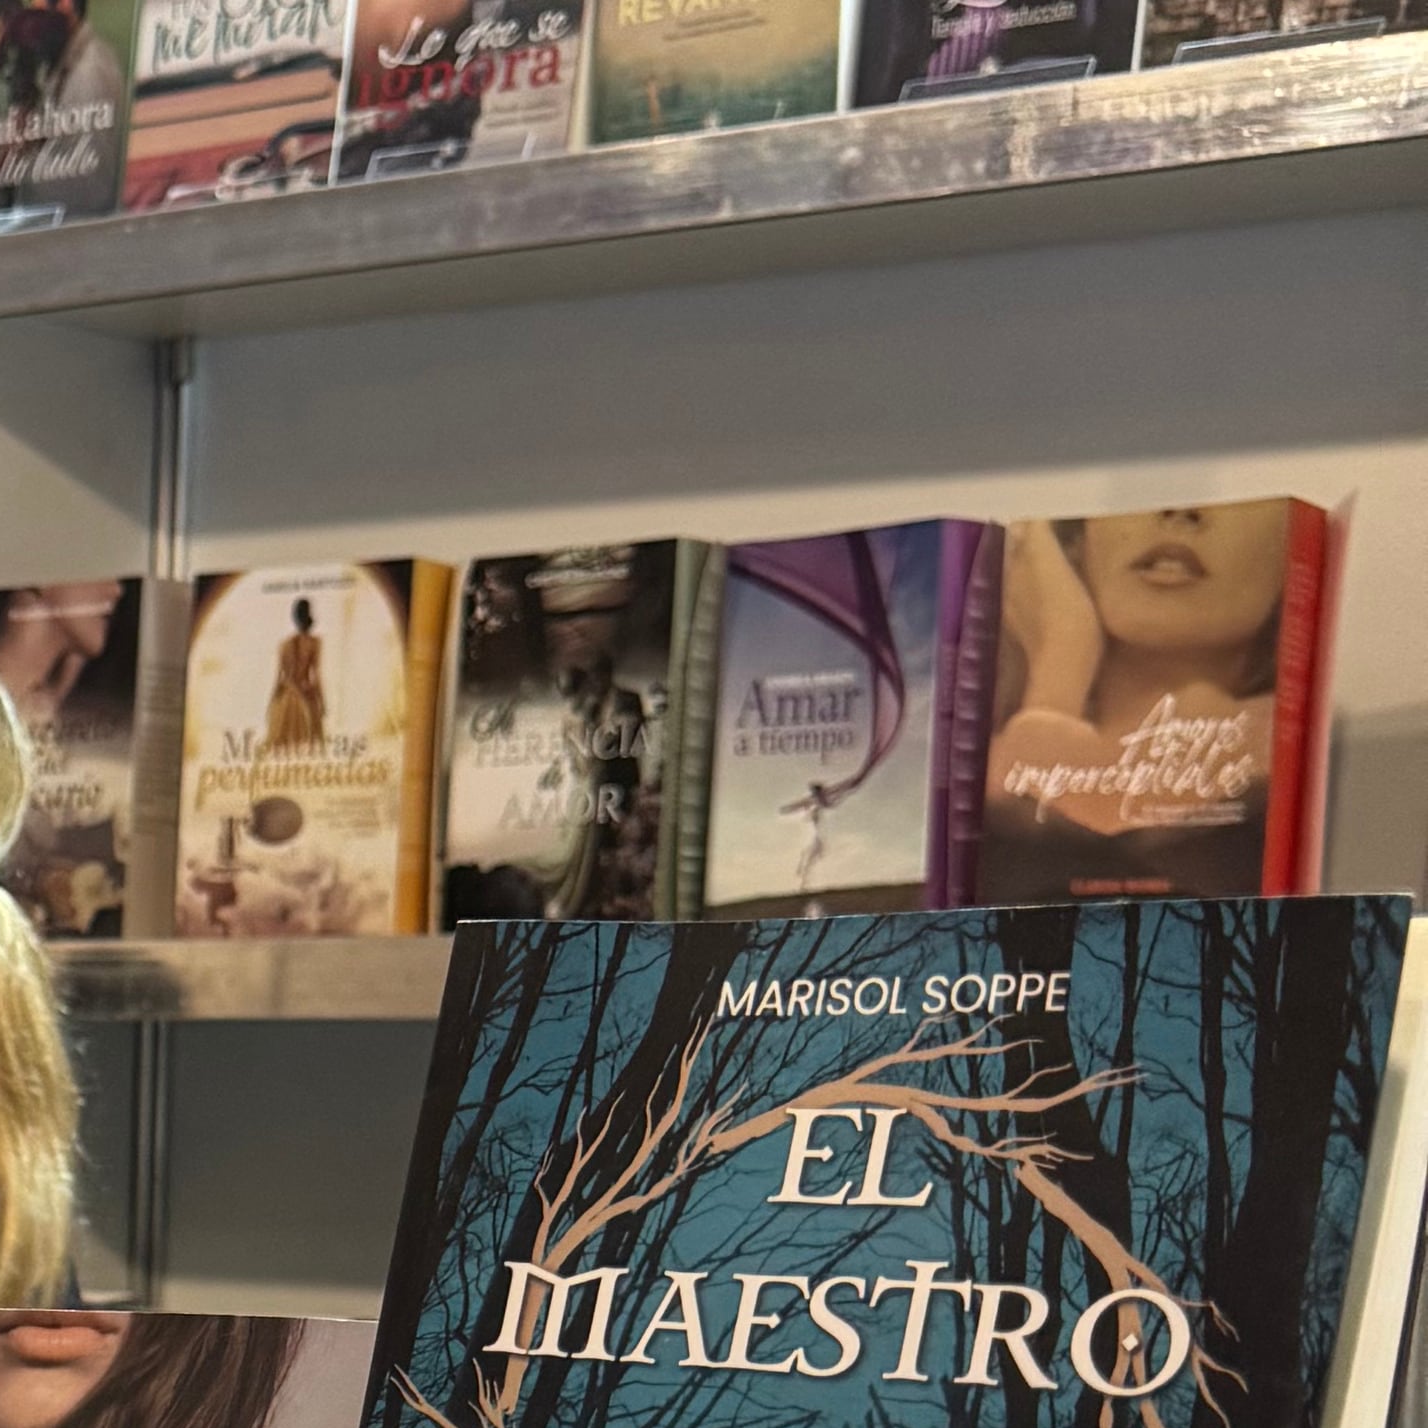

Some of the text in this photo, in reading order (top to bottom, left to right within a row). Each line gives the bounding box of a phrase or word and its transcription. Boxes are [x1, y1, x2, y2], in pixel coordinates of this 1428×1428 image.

[378, 16, 445, 69] Lo
[454, 20, 523, 72] que
[528, 9, 570, 42] se
[355, 44, 563, 130] ignora
[29, 104, 114, 143] ahora
[32, 135, 99, 178] lado
[734, 675, 865, 727] Amar
[473, 714, 663, 767] HERENCIA
[733, 724, 854, 762] a tiempo
[501, 787, 623, 831] AMOR
[717, 971, 1070, 1018] MARISOL SOPPE
[767, 1105, 933, 1207] EL
[483, 1260, 1191, 1397] MAESTRO
